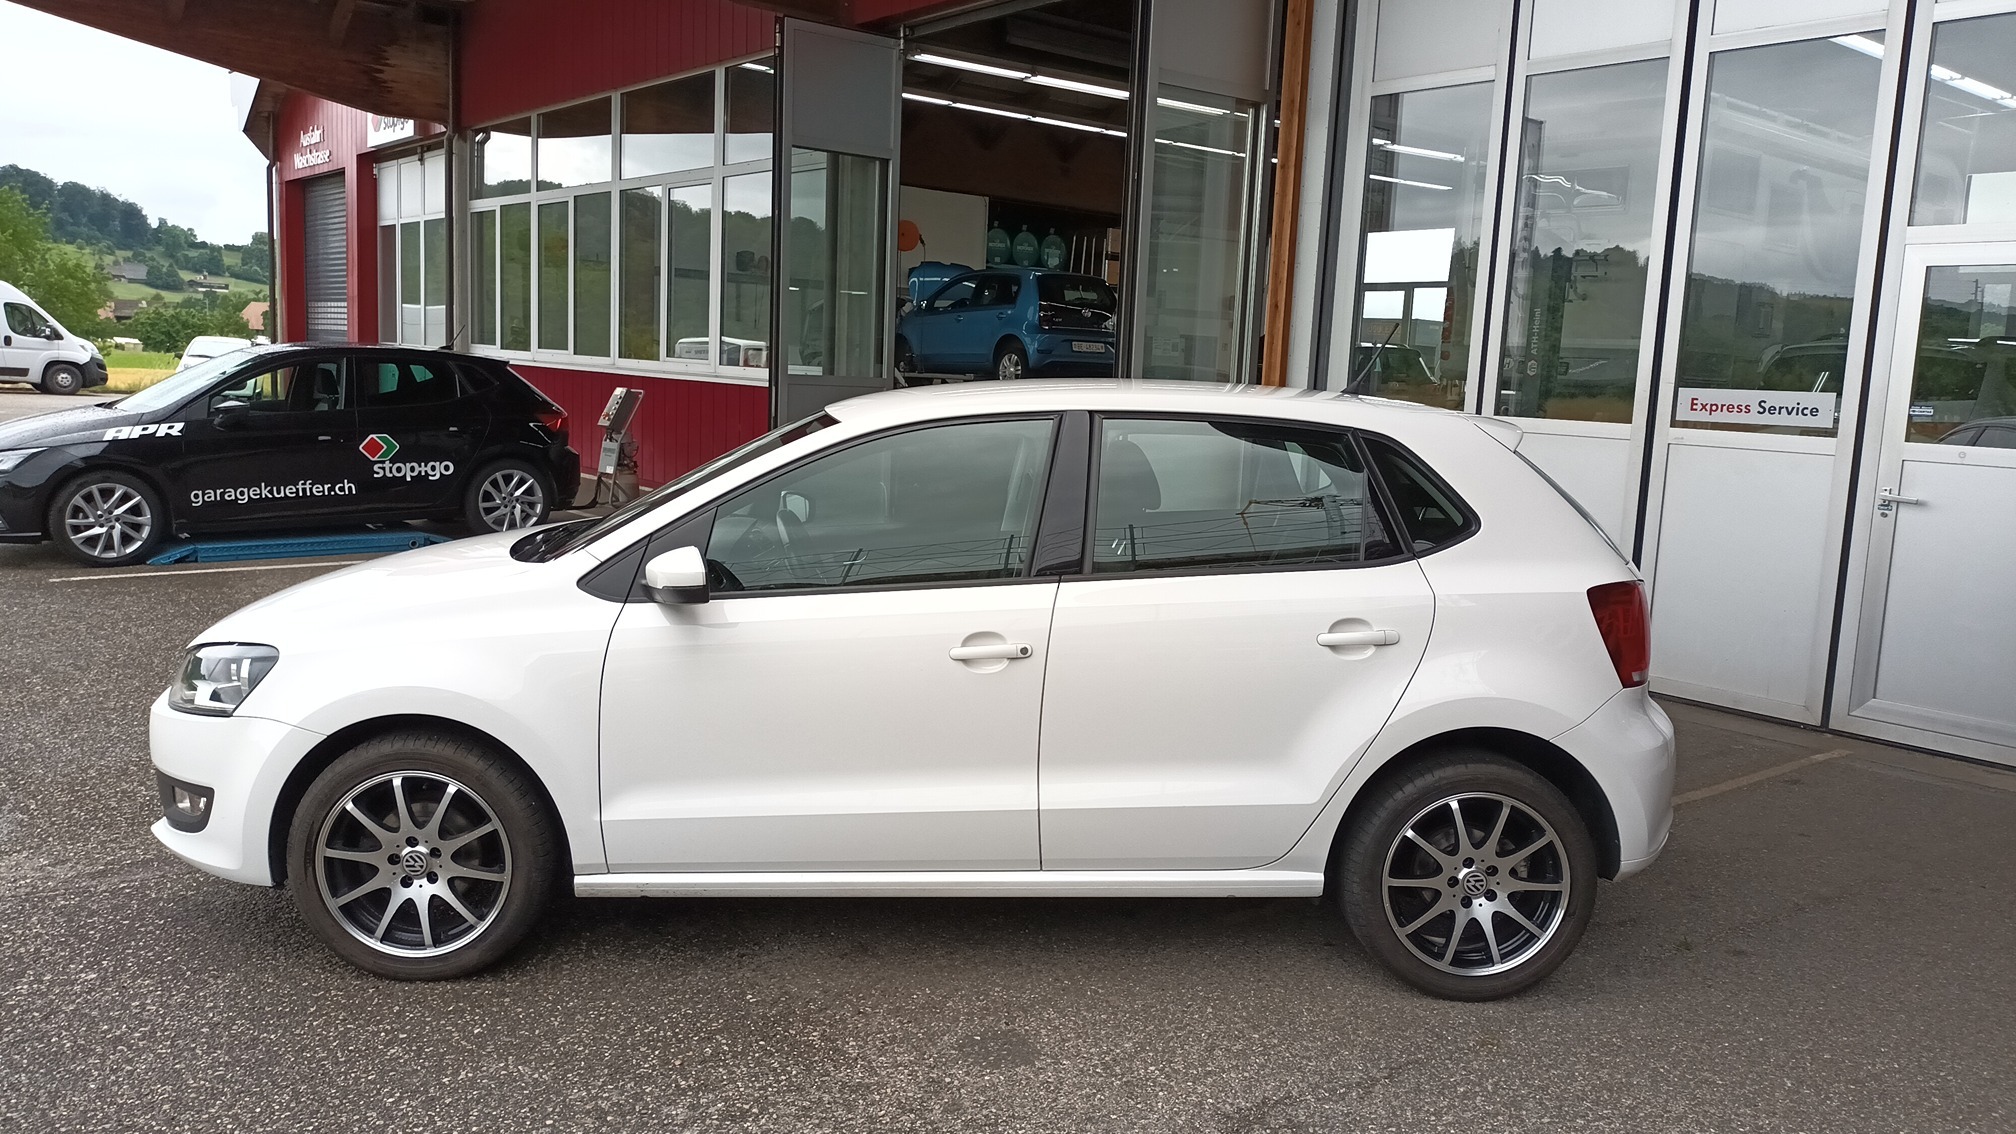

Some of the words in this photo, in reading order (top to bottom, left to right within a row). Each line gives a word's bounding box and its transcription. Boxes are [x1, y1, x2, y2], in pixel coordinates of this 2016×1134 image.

[300, 125, 324, 147] Ausfahrt
[293, 148, 331, 170] Waschstrasse
[1689, 397, 1751, 416] Express
[1756, 399, 1820, 418] Service
[102, 422, 186, 441] APR
[373, 460, 454, 481] stop+go
[190, 479, 357, 506] garagekueffer.ch
